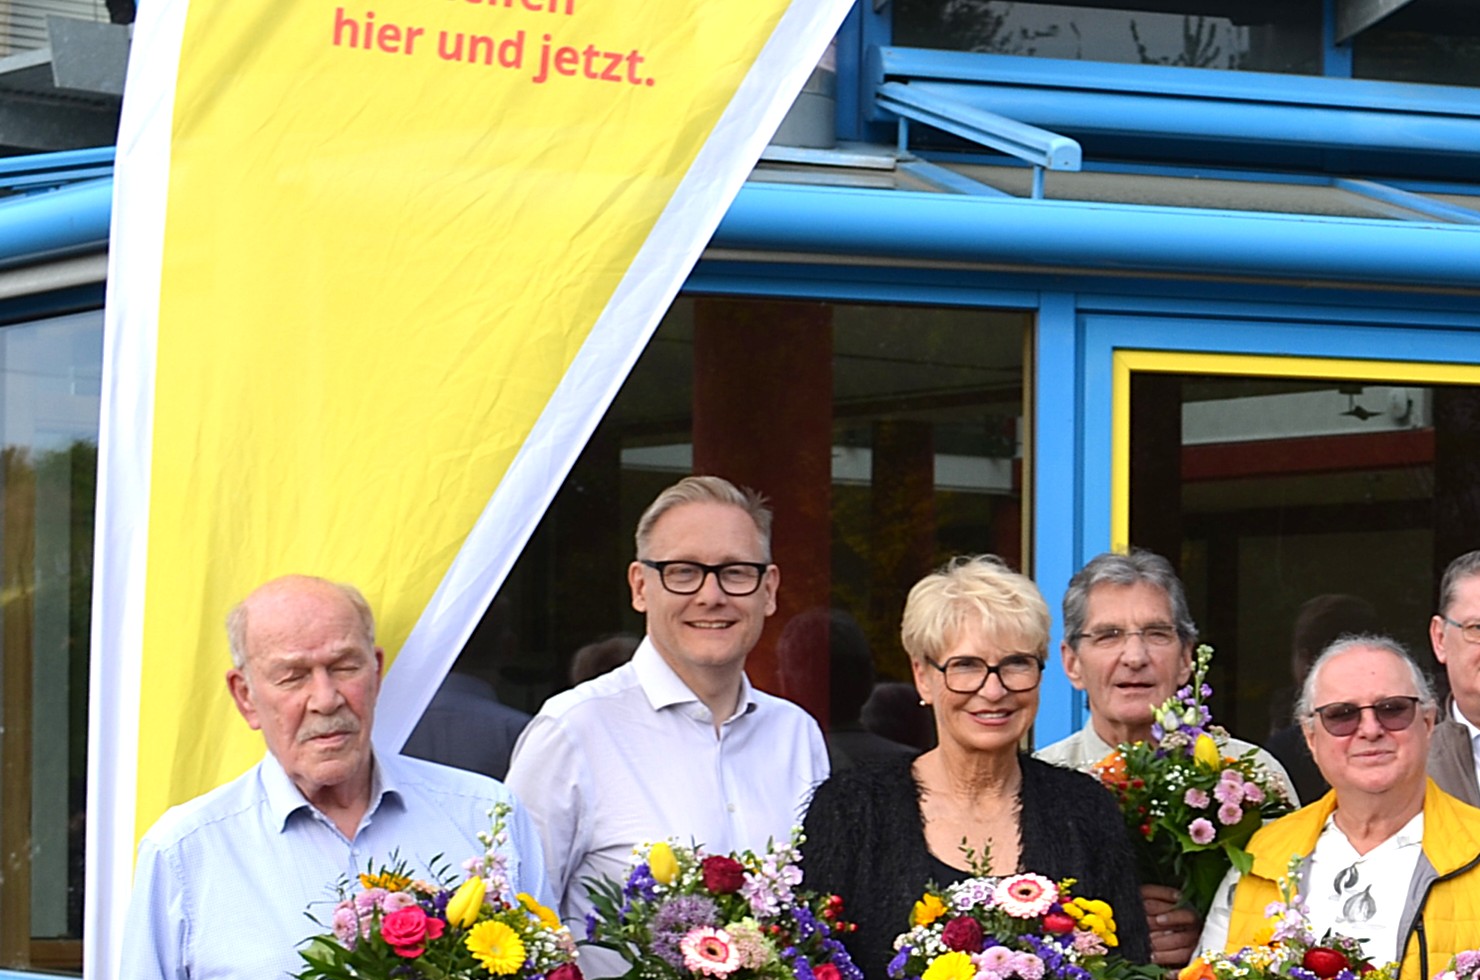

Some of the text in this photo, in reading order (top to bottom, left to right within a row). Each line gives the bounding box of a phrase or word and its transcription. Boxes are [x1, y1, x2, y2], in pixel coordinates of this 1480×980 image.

[332, 7, 656, 88] hier und jetzt.
